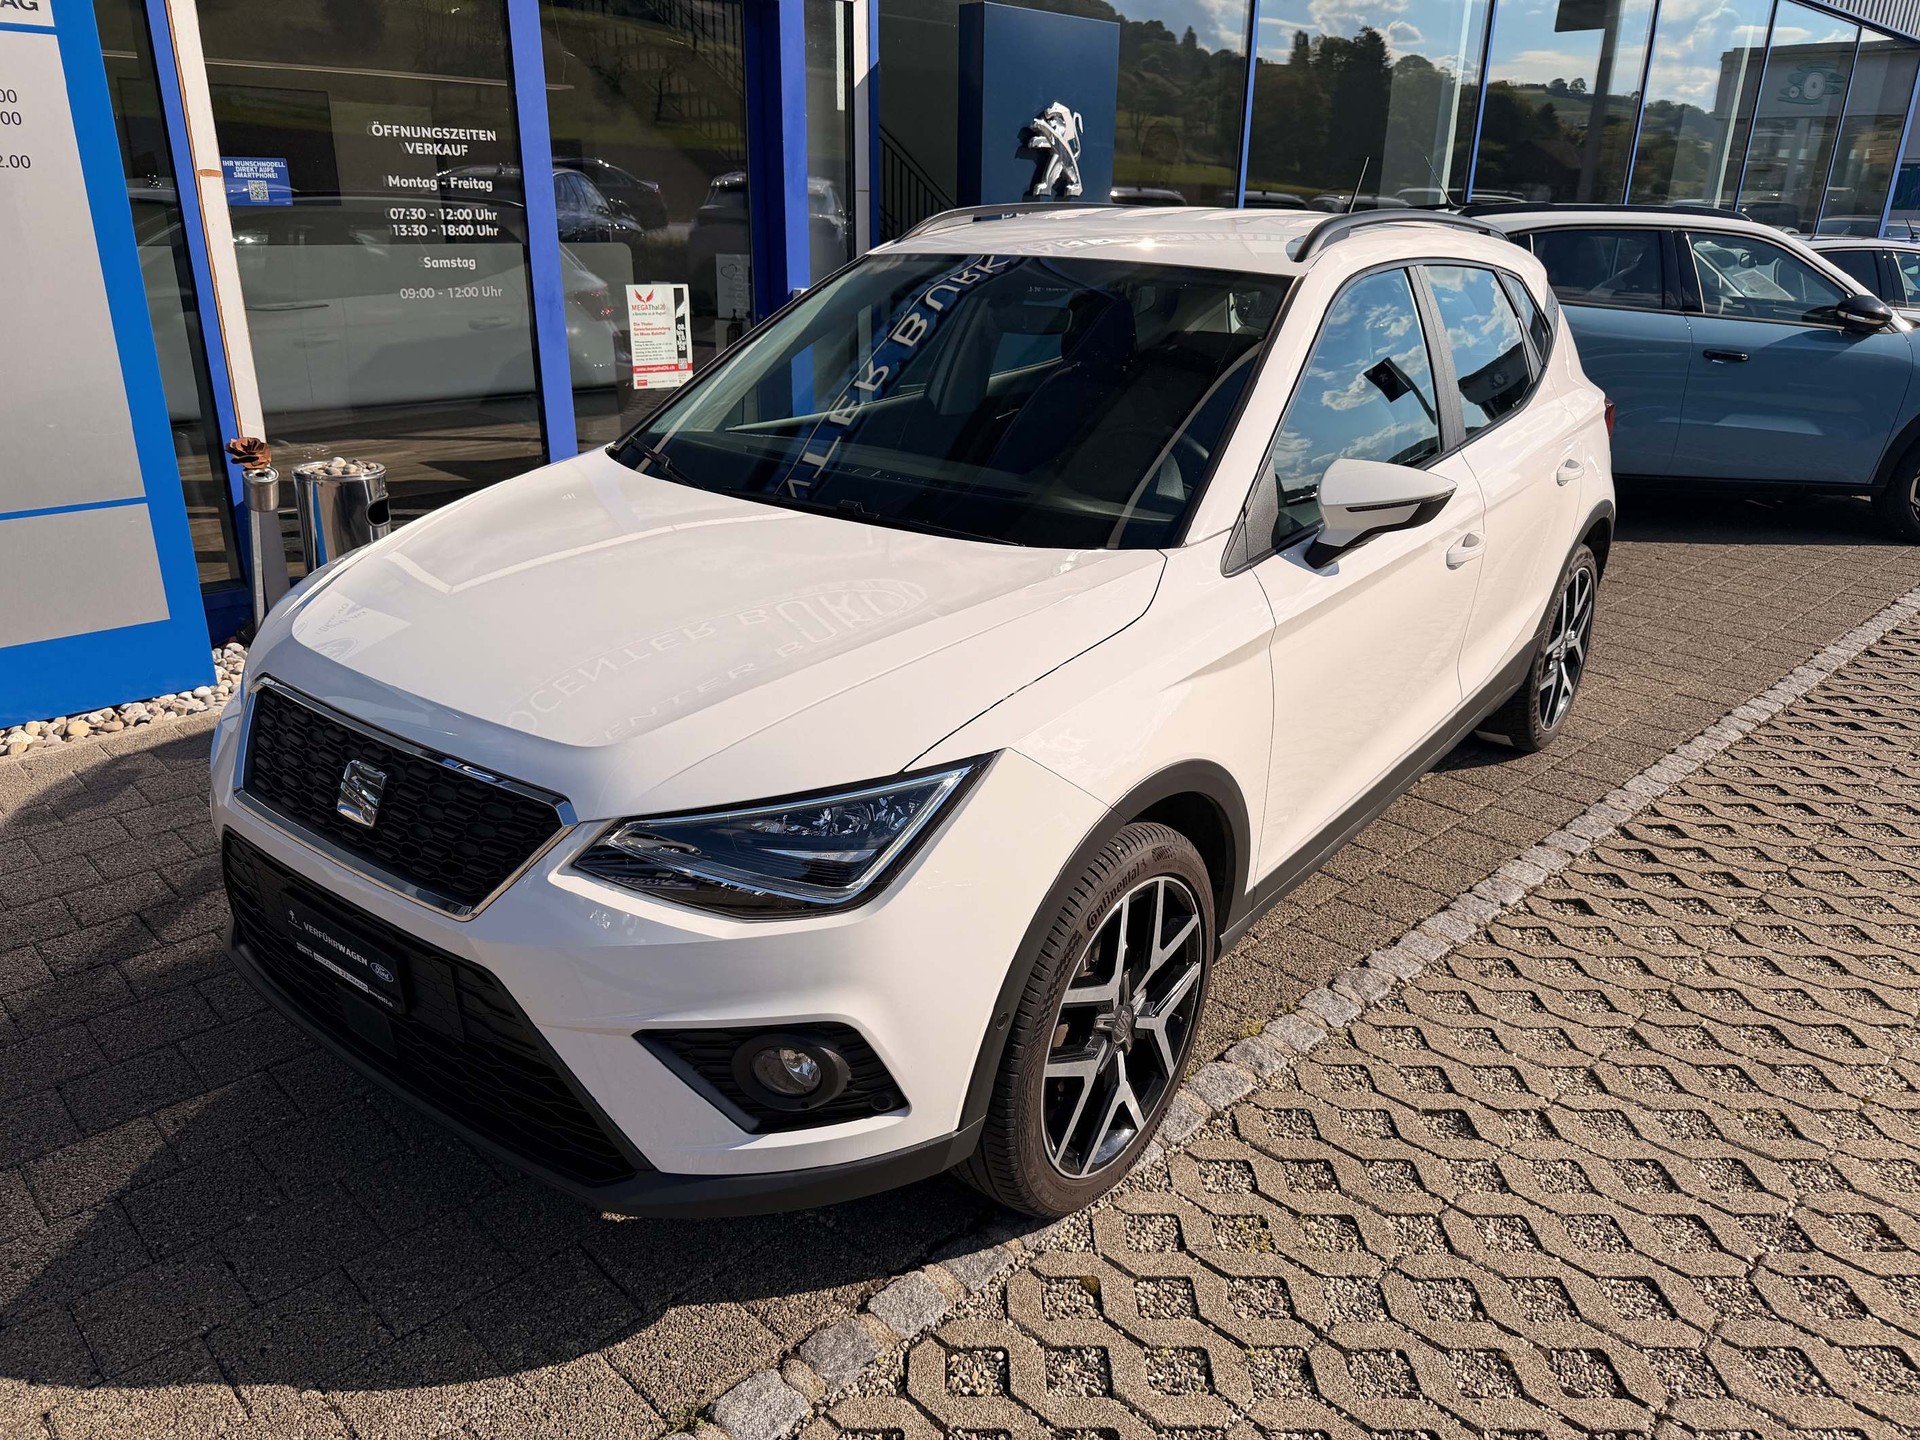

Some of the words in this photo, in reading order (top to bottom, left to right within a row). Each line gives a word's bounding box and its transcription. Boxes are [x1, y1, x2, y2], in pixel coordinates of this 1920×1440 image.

[371, 121, 497, 141] ÖFFNUNGSZEITEN
[405, 142, 468, 156] VERKAUF
[234, 160, 286, 168] WUNSCHMODELL
[387, 175, 438, 191] Montag
[450, 177, 493, 192] Freitag
[390, 208, 426, 220] 07:30
[439, 208, 473, 220] 12:00
[475, 209, 498, 220] Uhr
[393, 224, 428, 236] 13:30
[441, 224, 475, 236] 18:00
[477, 225, 499, 236] Uhr
[424, 257, 477, 270] Samstag
[400, 287, 435, 299] 09:00
[448, 287, 479, 298] 12:00
[482, 286, 503, 297] Uhr
[1086, 860, 1141, 932] Continental
